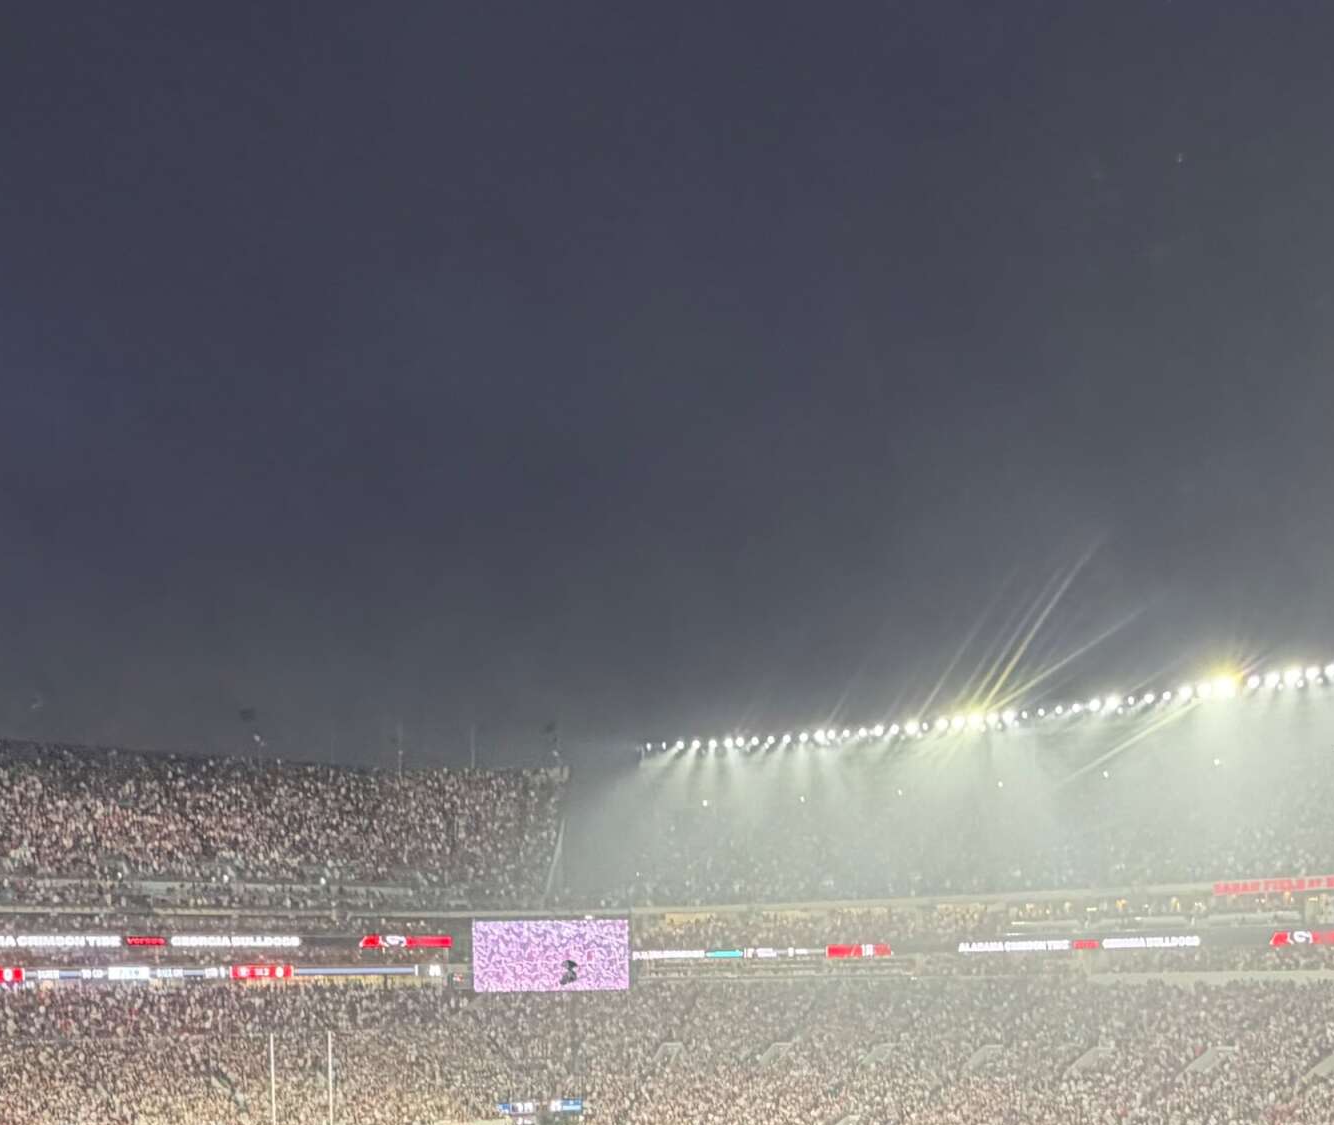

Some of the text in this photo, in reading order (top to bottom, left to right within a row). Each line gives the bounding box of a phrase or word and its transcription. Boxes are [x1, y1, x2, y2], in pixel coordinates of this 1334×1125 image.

[17, 934, 85, 948] CRIMSON
[86, 934, 122, 948] TIDE
[170, 935, 301, 947] GEORGIA BULLDOGS
